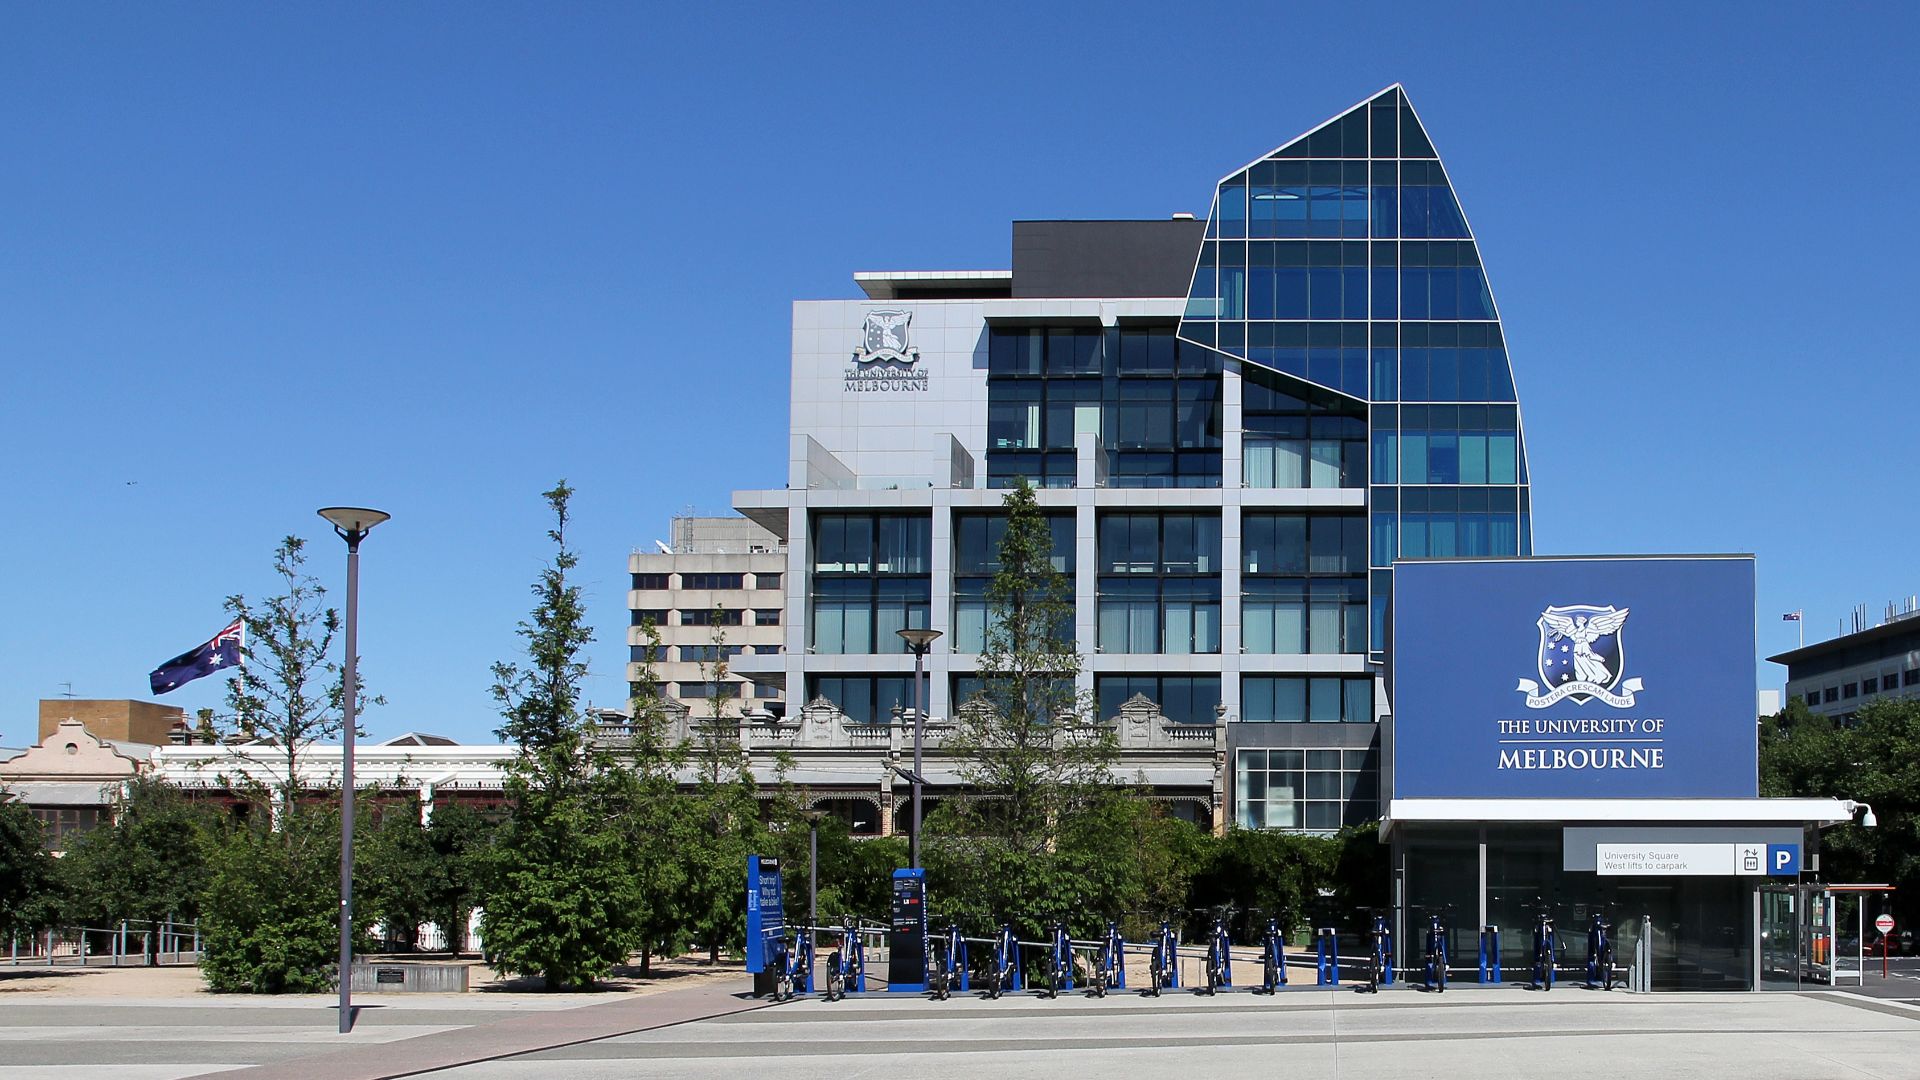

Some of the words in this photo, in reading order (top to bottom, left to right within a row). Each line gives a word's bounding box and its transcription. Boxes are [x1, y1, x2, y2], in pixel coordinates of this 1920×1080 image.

[864, 368, 916, 377] UNIVERSITY
[844, 381, 928, 392] MELBOURNE
[1529, 688, 1565, 706] POSTERA
[1566, 684, 1604, 697] CRESCAM
[1605, 694, 1632, 706] LAUDE
[1497, 720, 1530, 734] THE
[1535, 719, 1638, 734] UNIVERSITY
[1642, 719, 1664, 733] OF
[1497, 748, 1664, 769] MELBOURNE
[1604, 851, 1646, 861] University
[1648, 852, 1679, 861] Square
[1776, 851, 1791, 870] P
[1604, 862, 1626, 870] West
[1627, 862, 1643, 870] lifts
[1645, 862, 1654, 870] to
[1656, 862, 1688, 872] carpark
